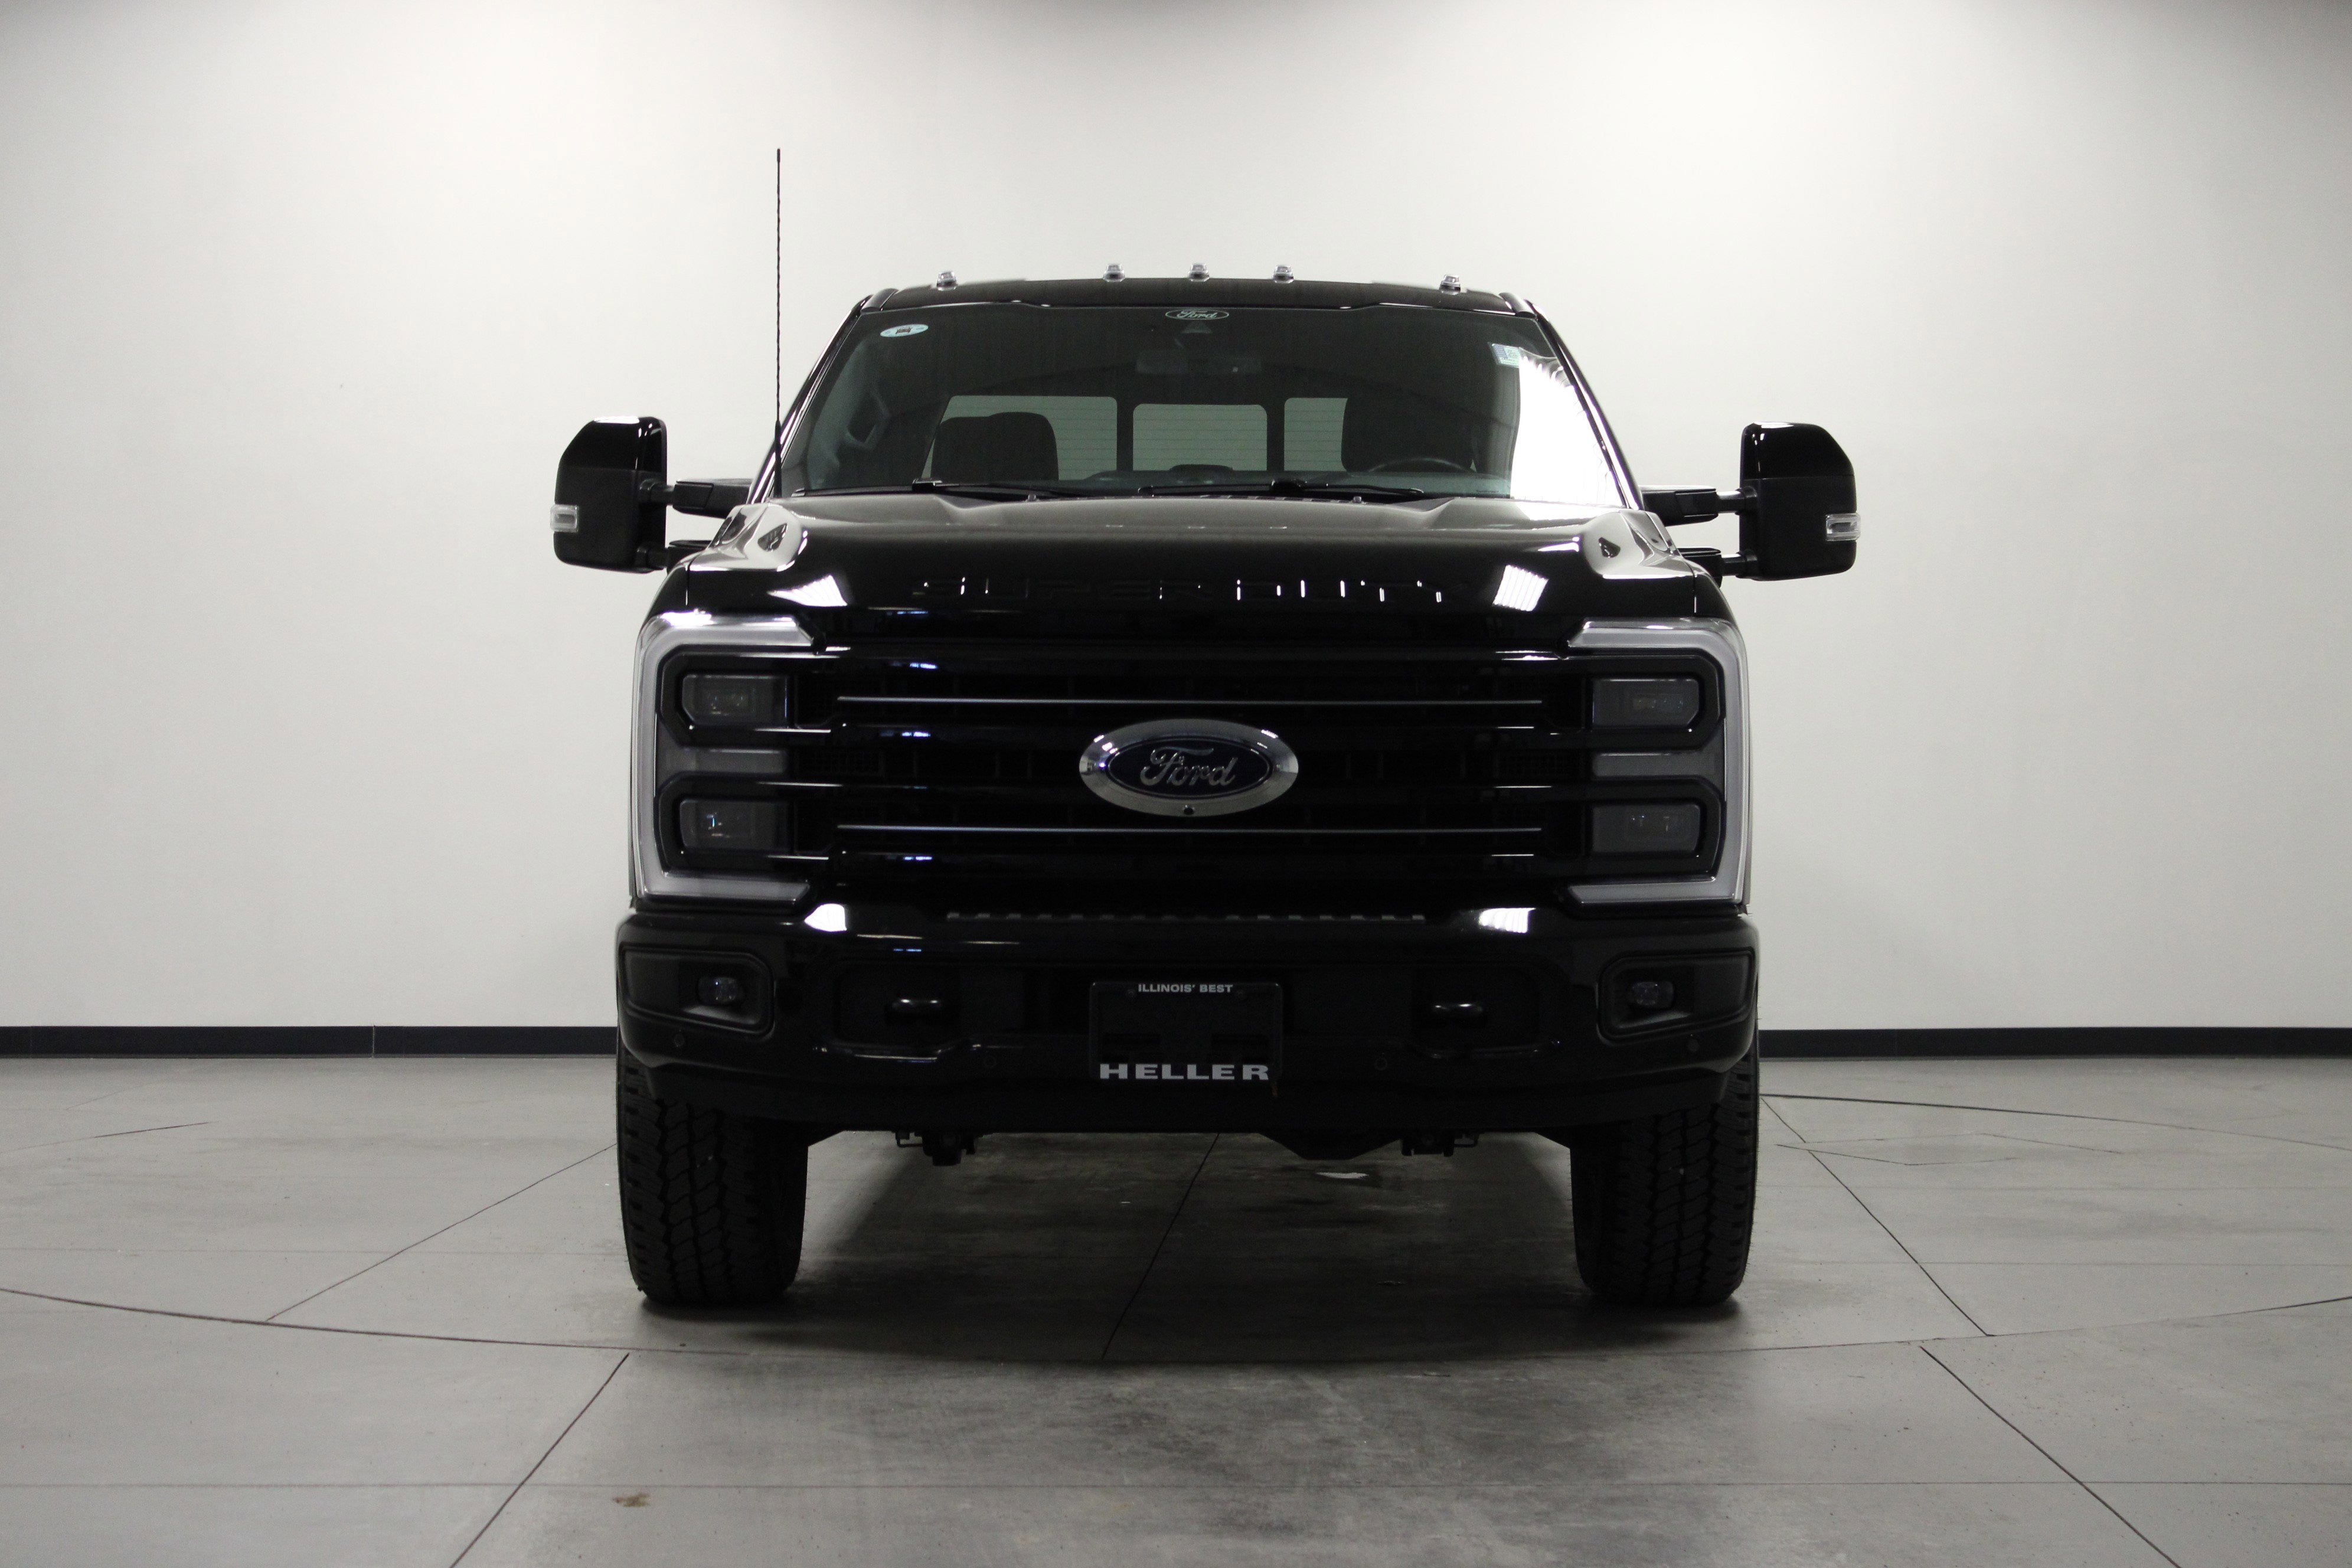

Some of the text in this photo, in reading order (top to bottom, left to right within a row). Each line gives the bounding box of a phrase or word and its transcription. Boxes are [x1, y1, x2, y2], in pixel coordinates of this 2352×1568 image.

[1177, 309, 1218, 319] Ford
[1140, 746, 1239, 786] Ford
[1138, 984, 1233, 993] ILLINOIS' BEST
[1100, 1064, 1269, 1080] HELLER
